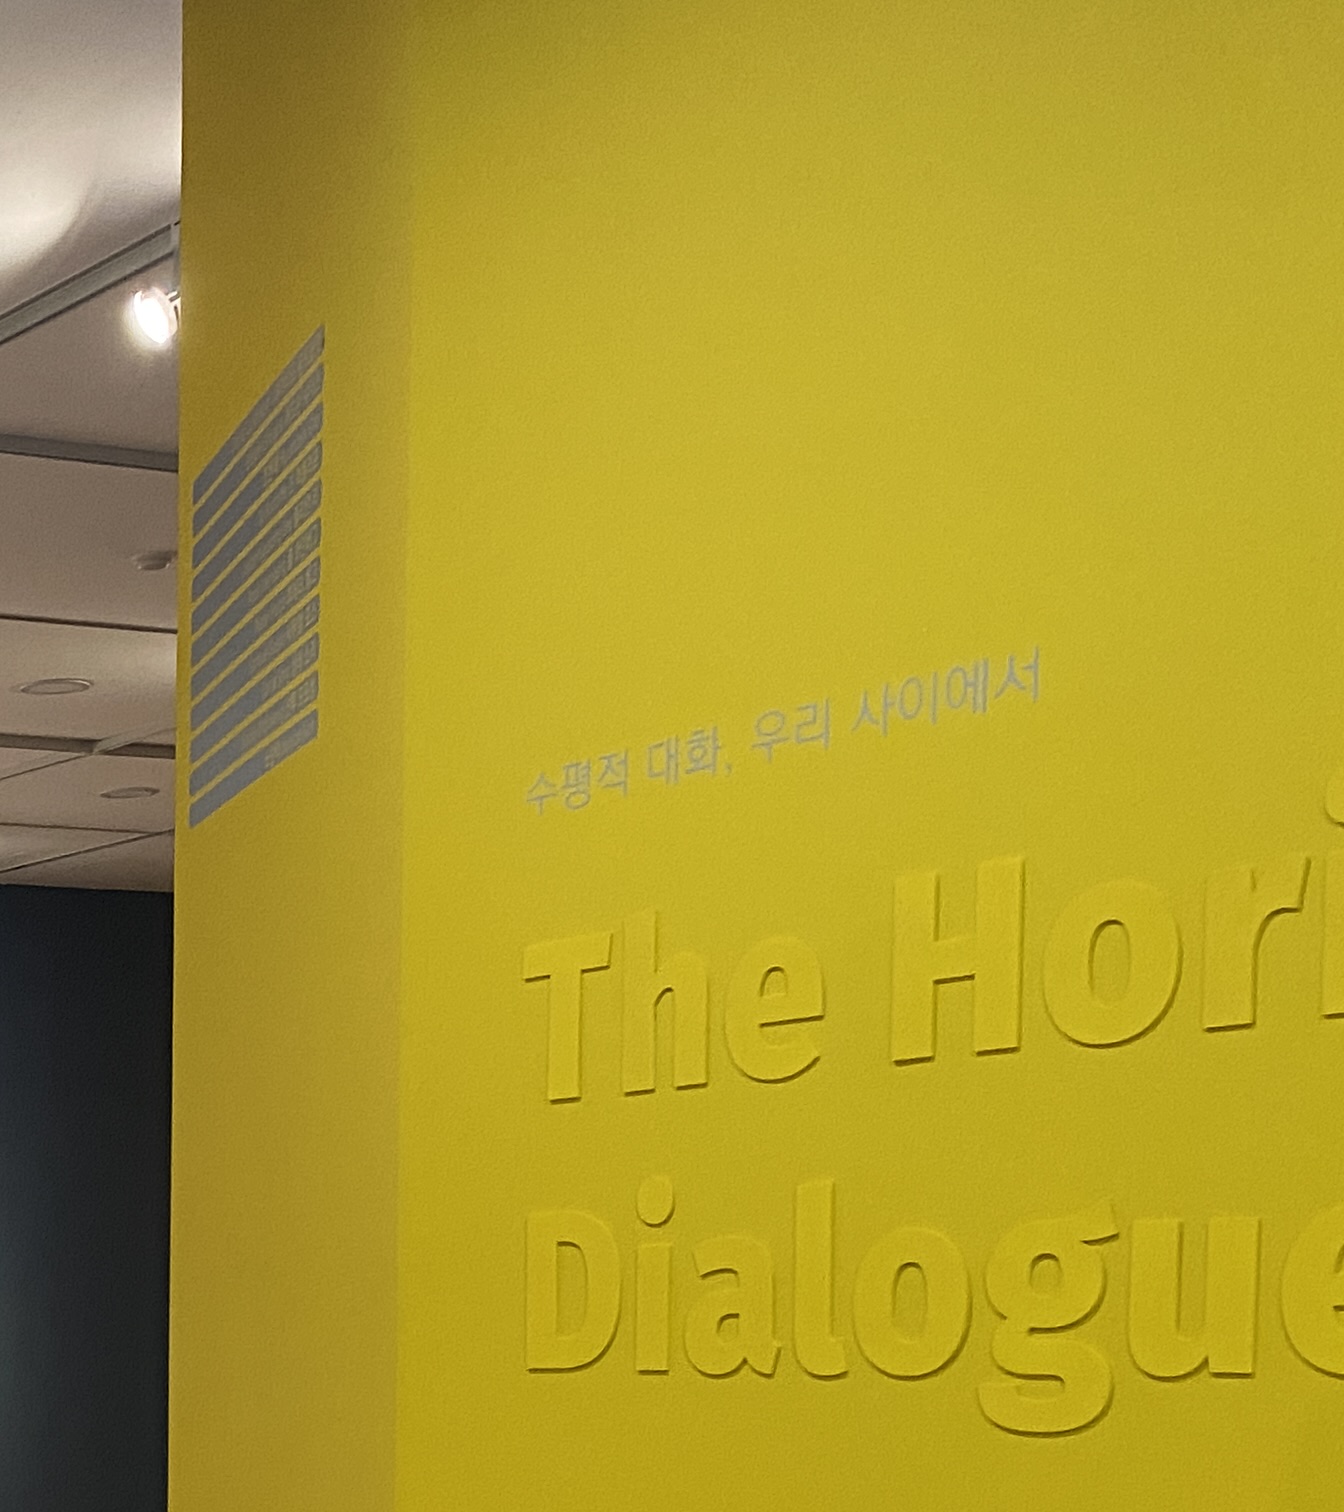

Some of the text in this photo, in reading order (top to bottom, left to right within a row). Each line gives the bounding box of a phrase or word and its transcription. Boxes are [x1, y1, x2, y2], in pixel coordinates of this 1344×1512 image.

[526, 645, 1041, 816] 수평적 대화, 우리 사이에서
[522, 907, 826, 1105] The
